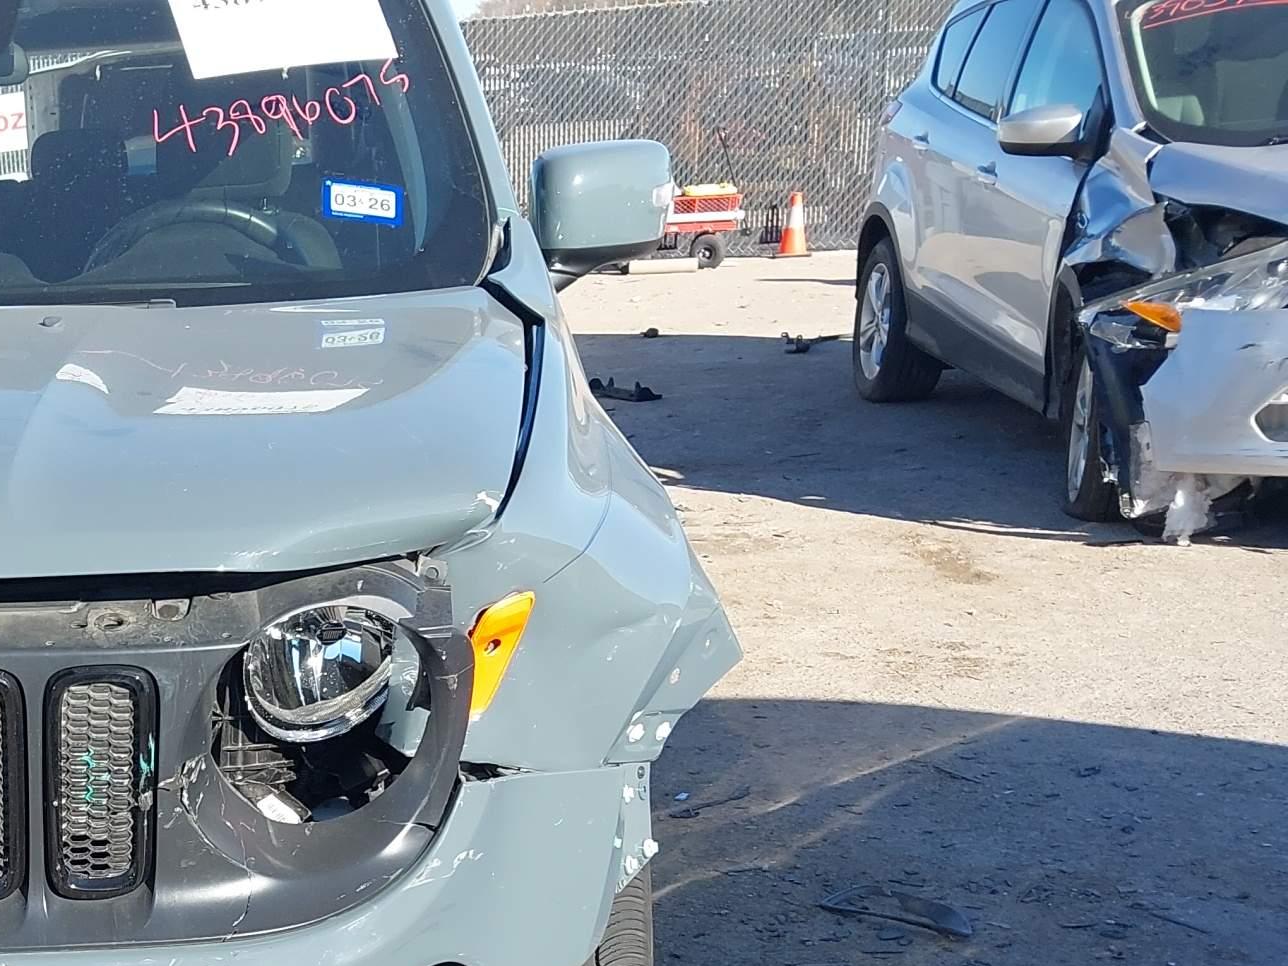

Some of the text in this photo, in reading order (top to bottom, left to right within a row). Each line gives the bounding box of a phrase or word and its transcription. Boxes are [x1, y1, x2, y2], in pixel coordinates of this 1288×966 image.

[153, 58, 409, 156] 43896075
[334, 193, 391, 211] 03 26
